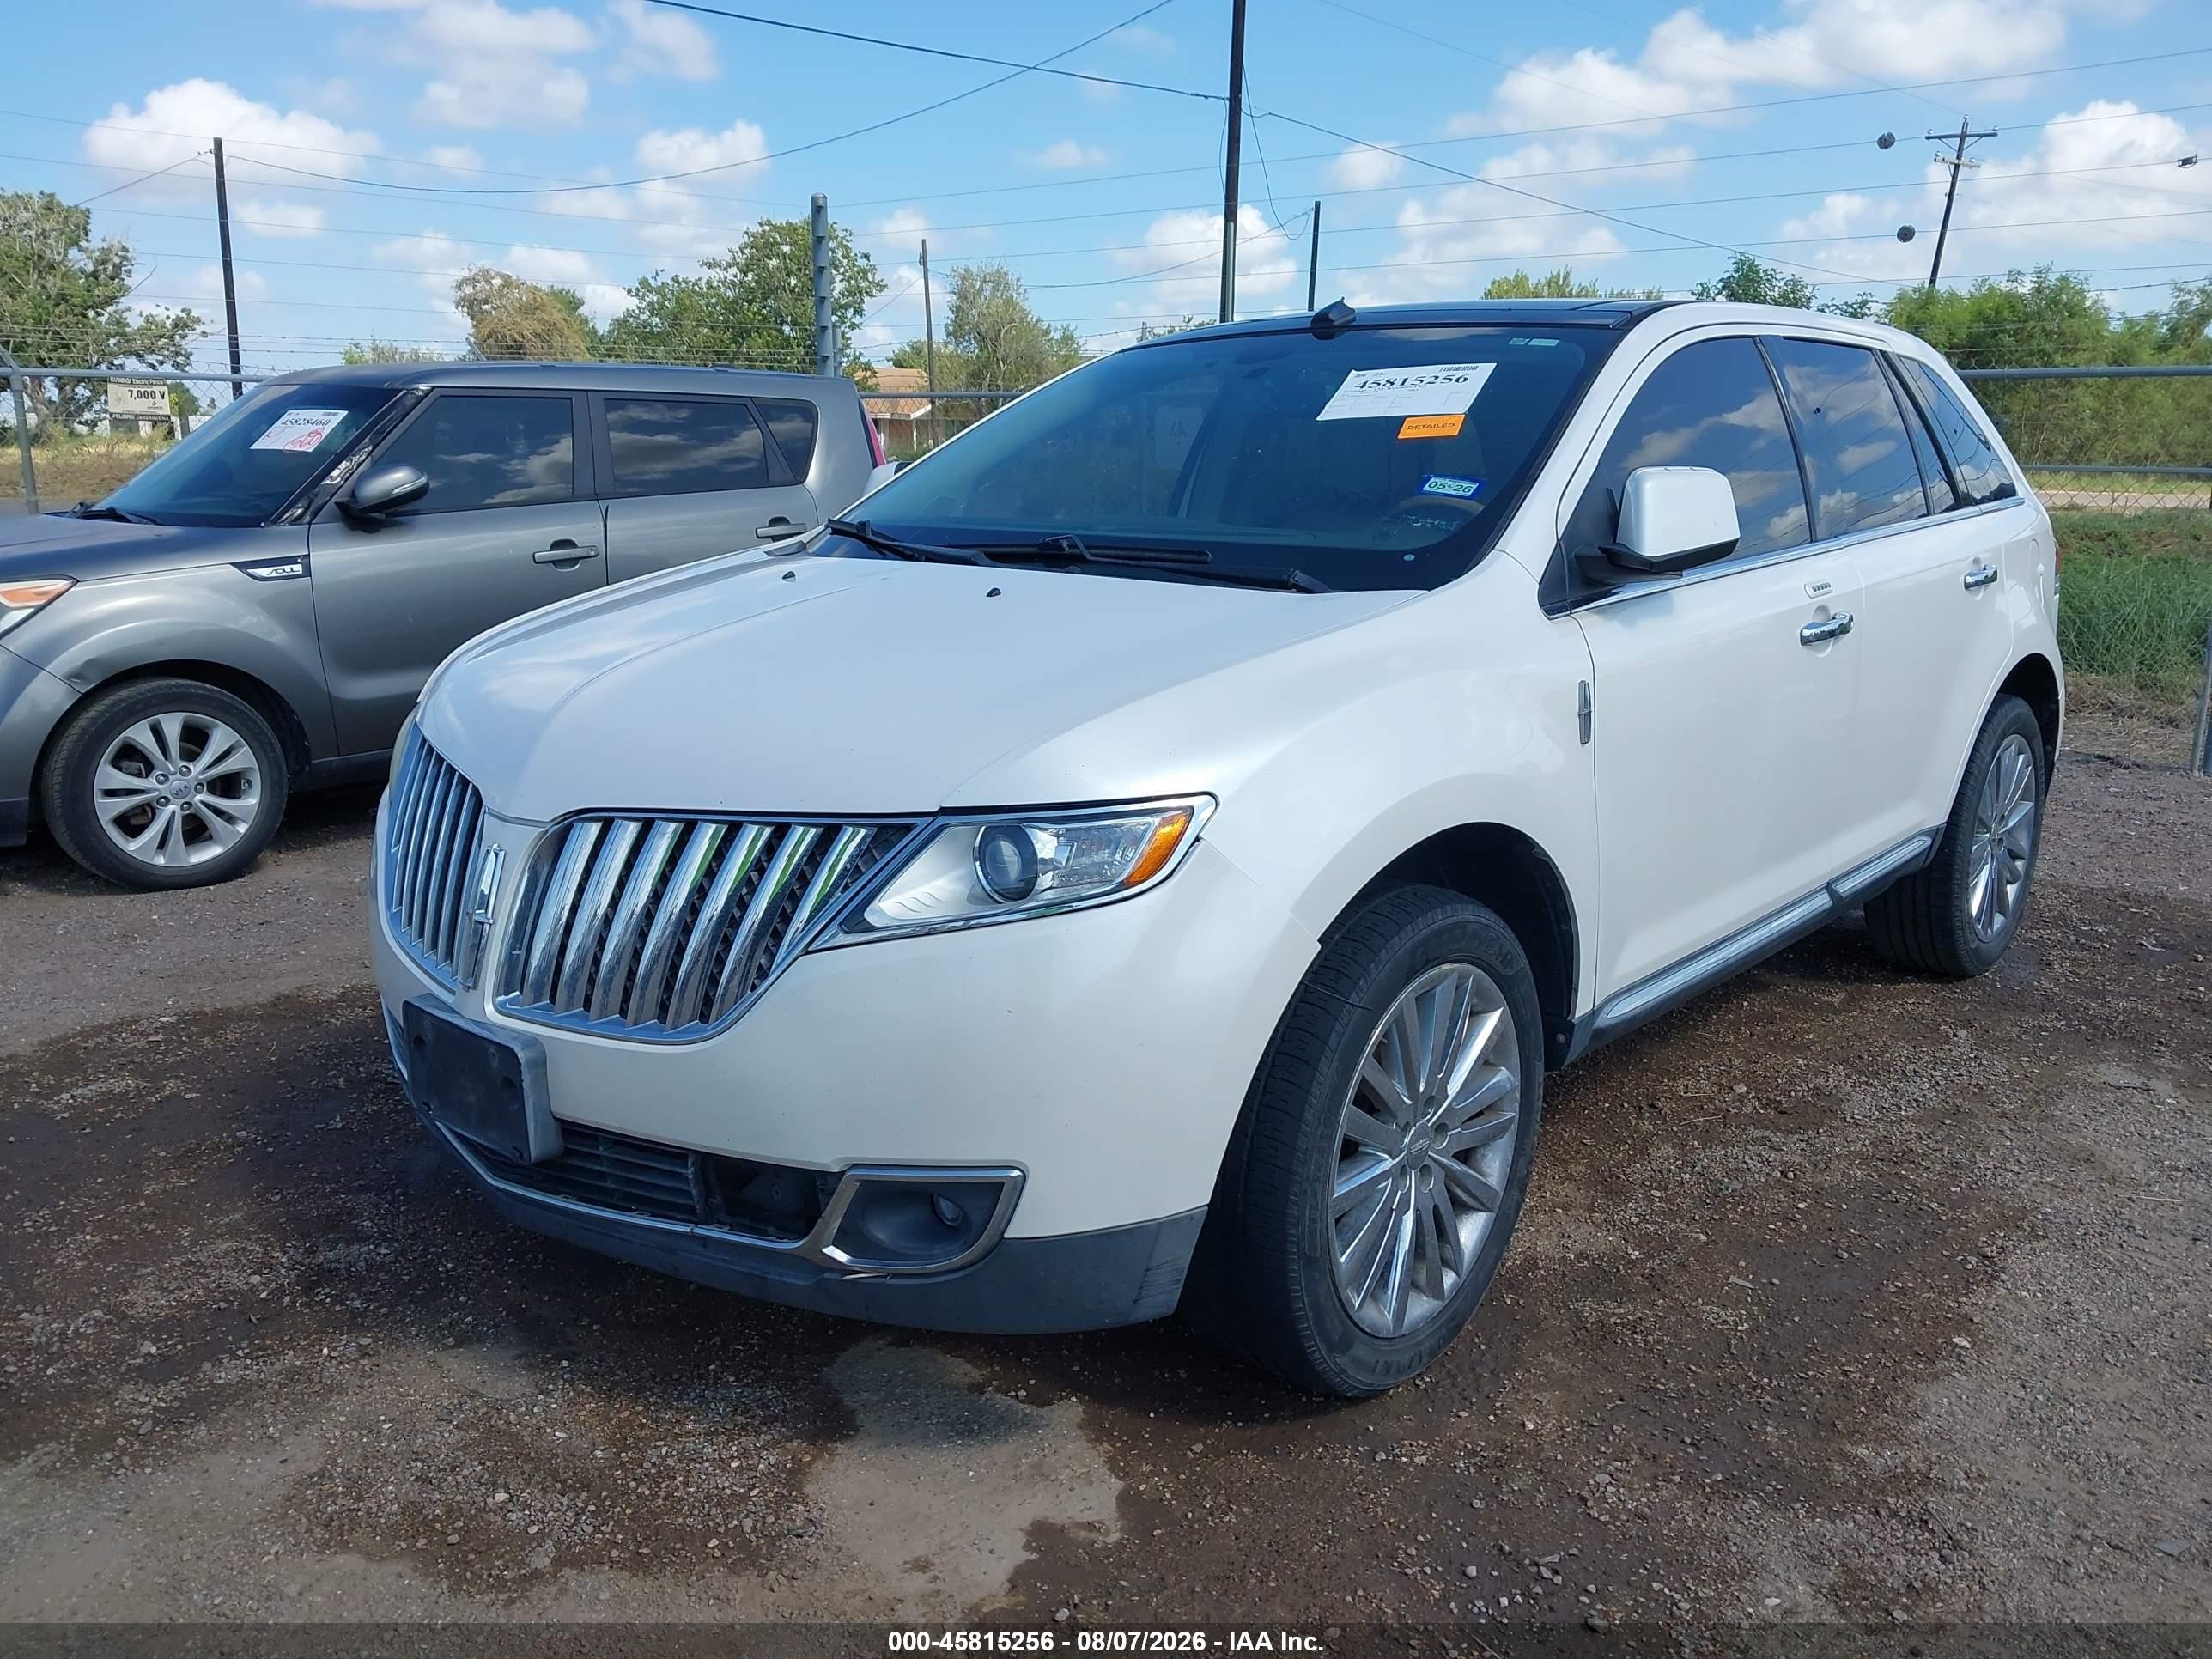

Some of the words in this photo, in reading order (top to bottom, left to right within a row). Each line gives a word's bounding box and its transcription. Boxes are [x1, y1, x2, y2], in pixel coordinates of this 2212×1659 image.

[1354, 374, 1469, 388] 45815256
[128, 389, 156, 401] 7,000
[158, 390, 166, 400] V
[281, 418, 331, 427] 45828460
